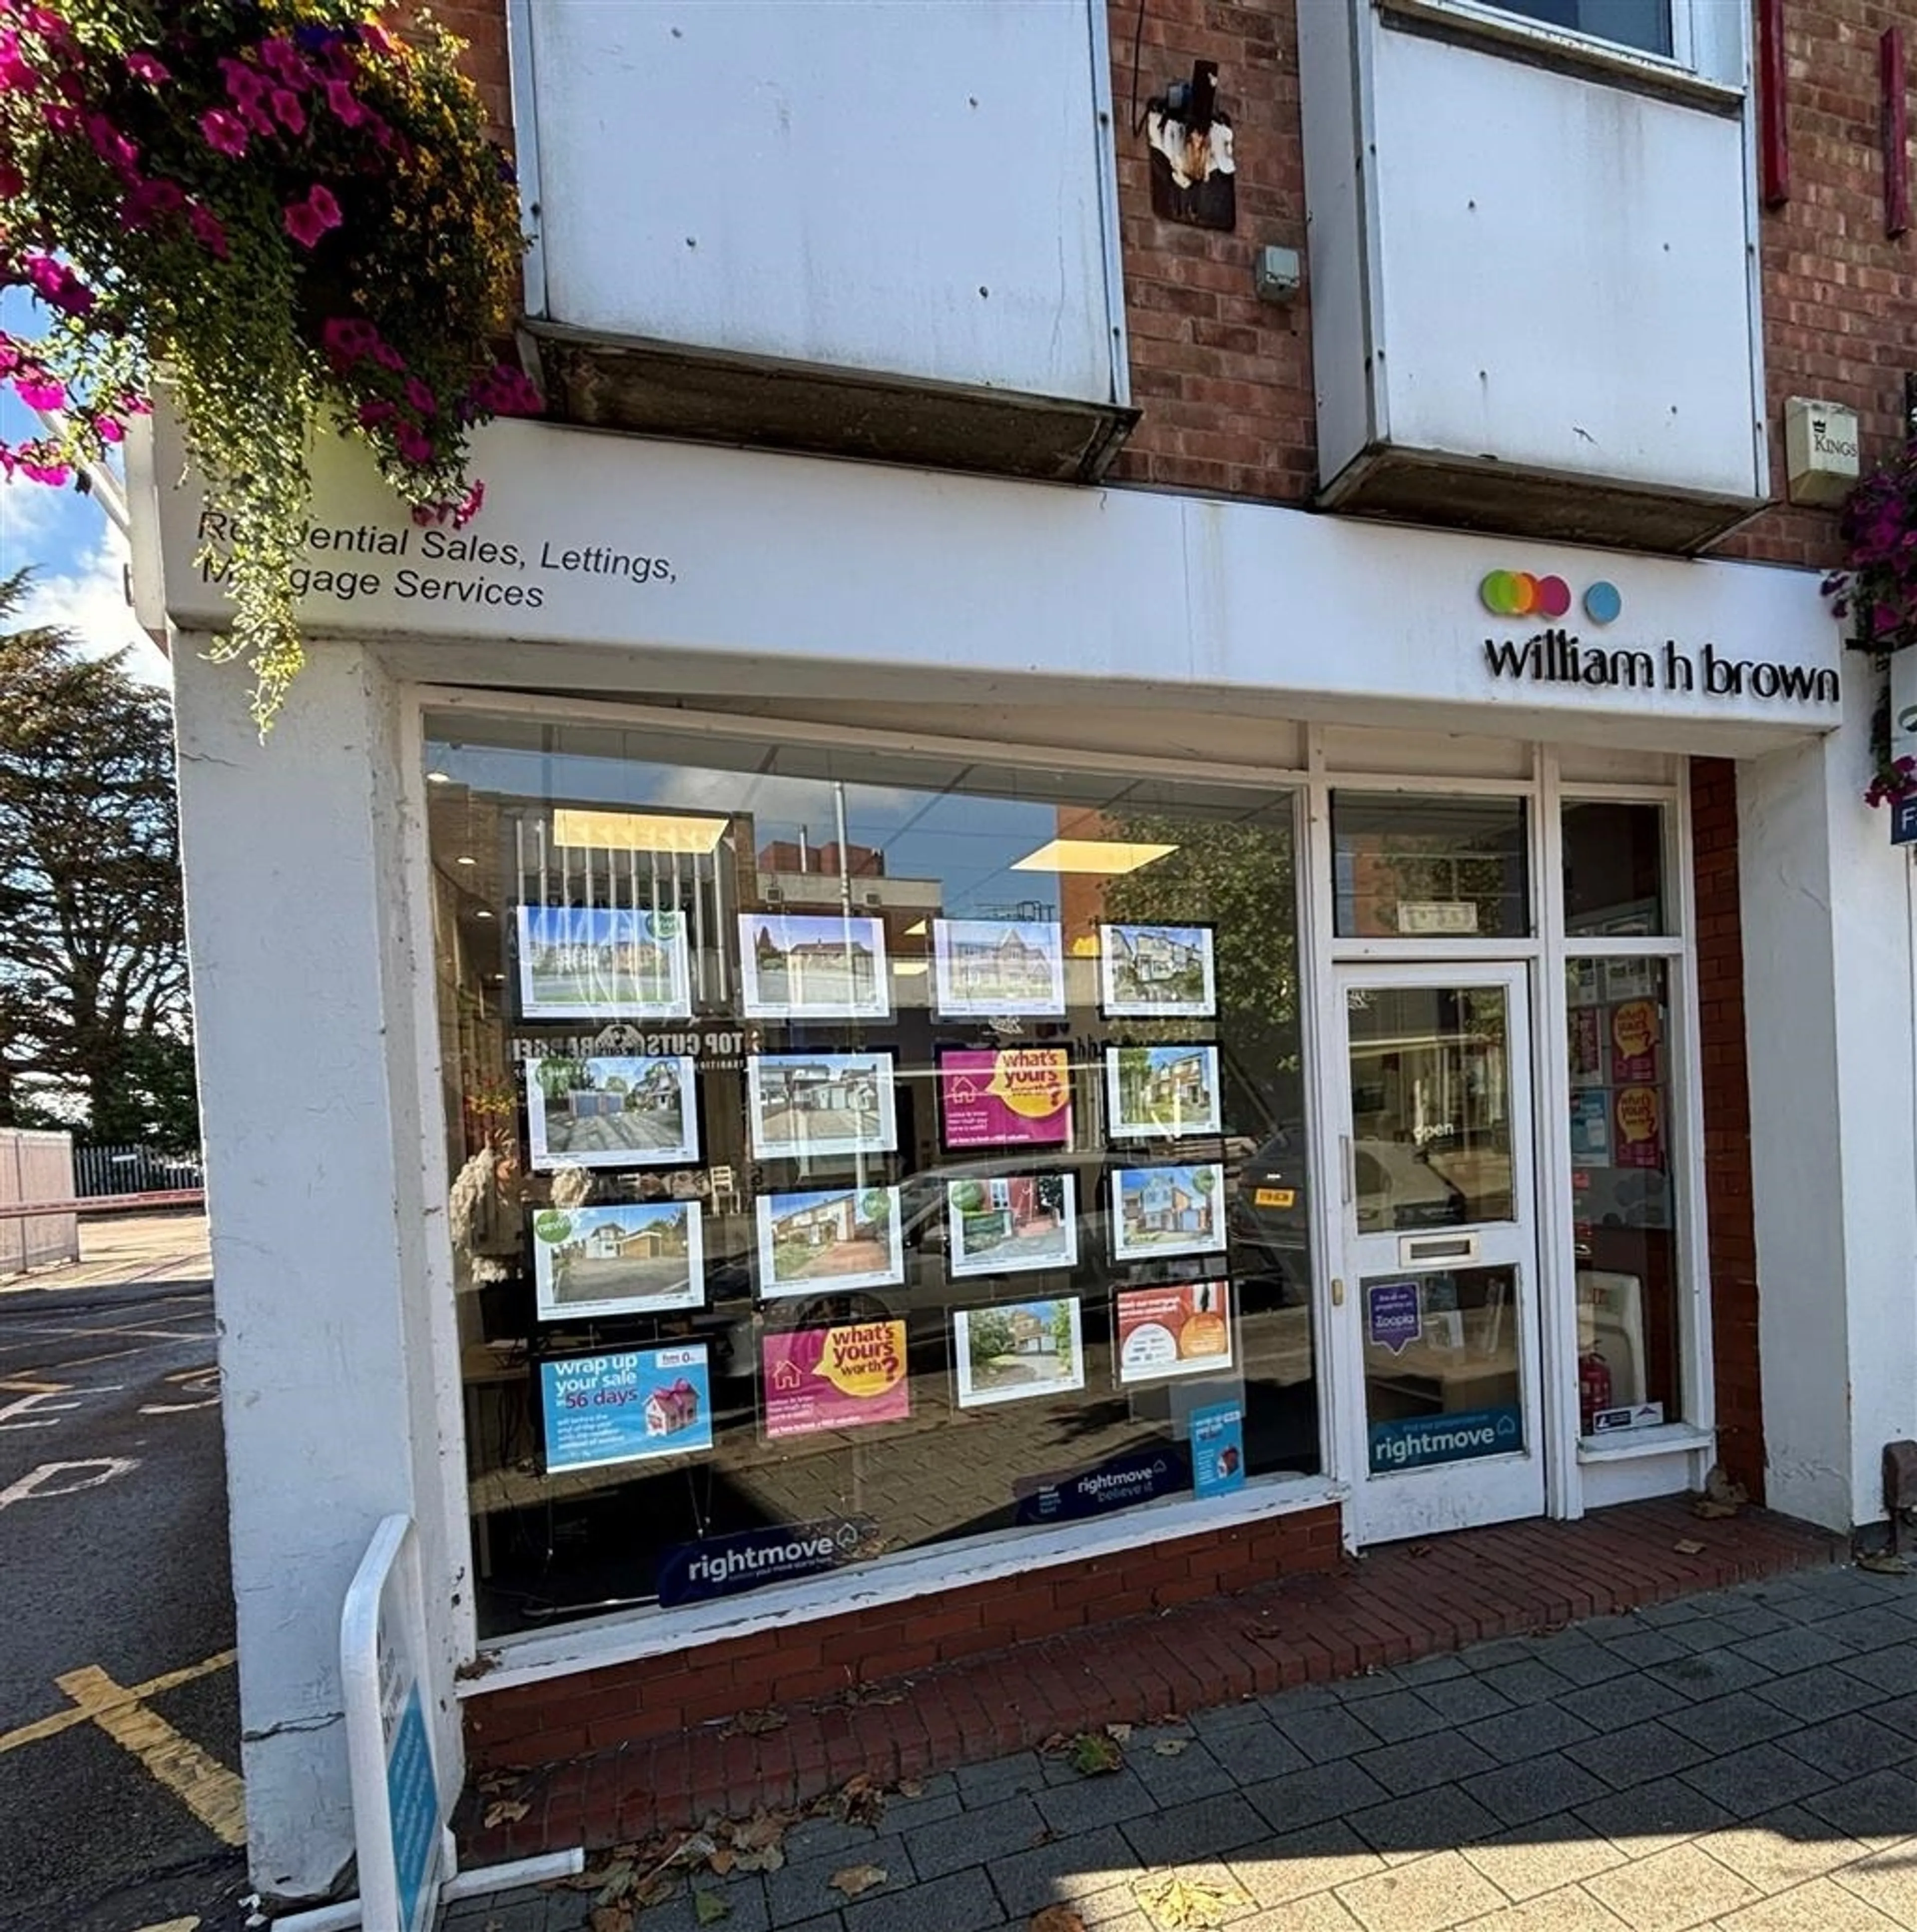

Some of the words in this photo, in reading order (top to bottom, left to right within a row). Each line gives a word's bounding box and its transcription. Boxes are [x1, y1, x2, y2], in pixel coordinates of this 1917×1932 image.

[1814, 434, 1858, 457] KINGS
[421, 531, 527, 570] Sales,
[540, 542, 678, 584] Lettings,
[203, 555, 380, 598] Mgage
[394, 570, 544, 608] Services
[1484, 629, 1654, 688] william
[1663, 641, 1693, 691] h
[1703, 644, 1840, 702] brown
[1002, 1048, 1058, 1067] what's
[832, 1323, 894, 1345] what's
[612, 1353, 638, 1371] up
[833, 1340, 894, 1368] yours
[555, 1377, 598, 1397] your
[602, 1369, 638, 1388] sale
[565, 1391, 589, 1409] 56
[593, 1388, 639, 1407] days
[1375, 1427, 1496, 1463] rightmove
[1078, 1468, 1153, 1495] rightmove
[688, 1537, 834, 1583] rightmove
